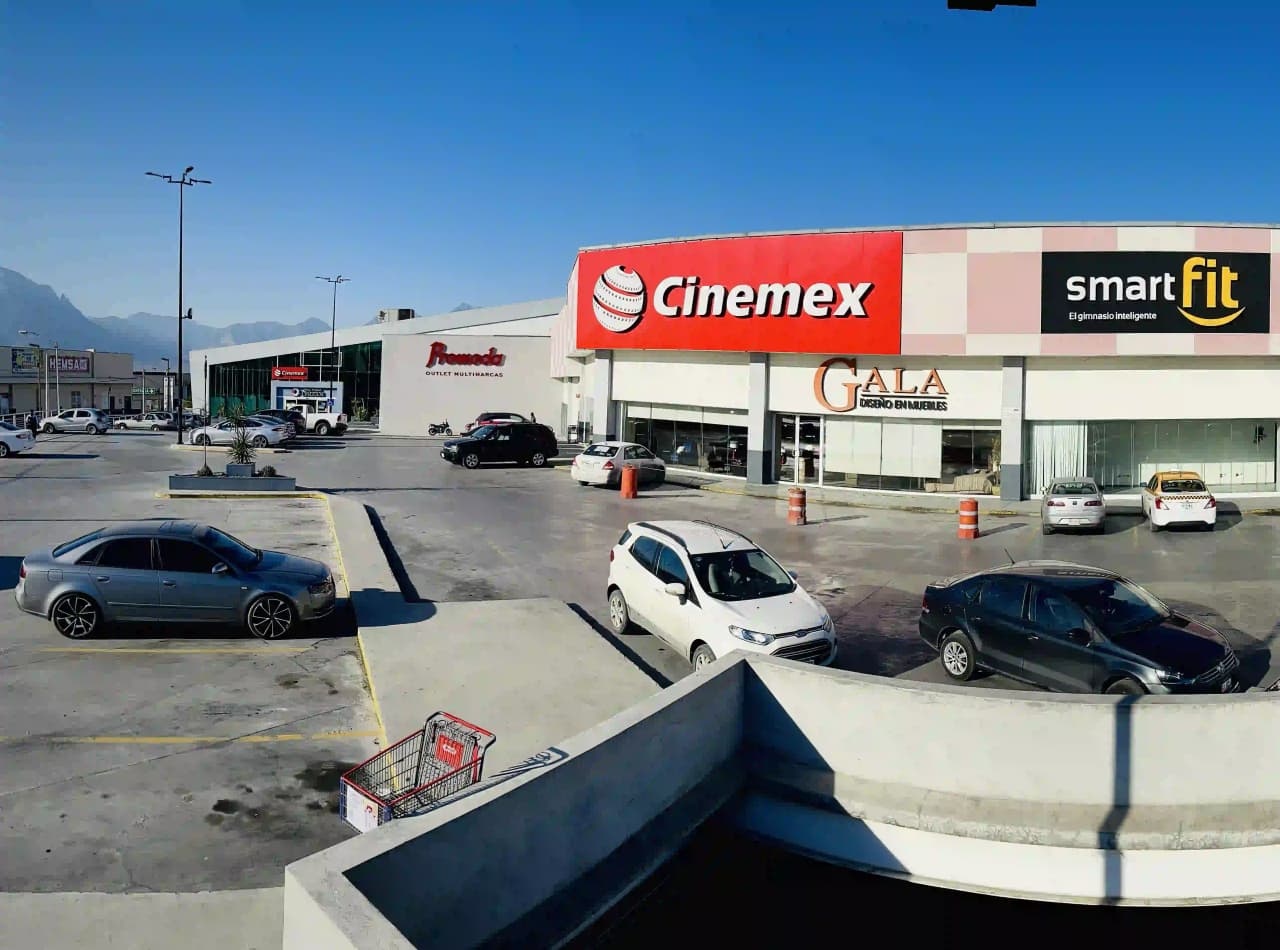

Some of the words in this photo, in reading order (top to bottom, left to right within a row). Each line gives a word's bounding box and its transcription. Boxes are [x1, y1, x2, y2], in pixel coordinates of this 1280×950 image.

[653, 275, 875, 318] Cinemex
[1066, 272, 1176, 301] smart
[1182, 256, 1239, 309] fit
[1069, 312, 1077, 320] El
[1078, 312, 1115, 322] gimnasio
[1115, 311, 1157, 321] inteligente
[813, 357, 949, 412] GALA
[894, 399, 907, 410] EN
[908, 400, 948, 412] MUEBLES
